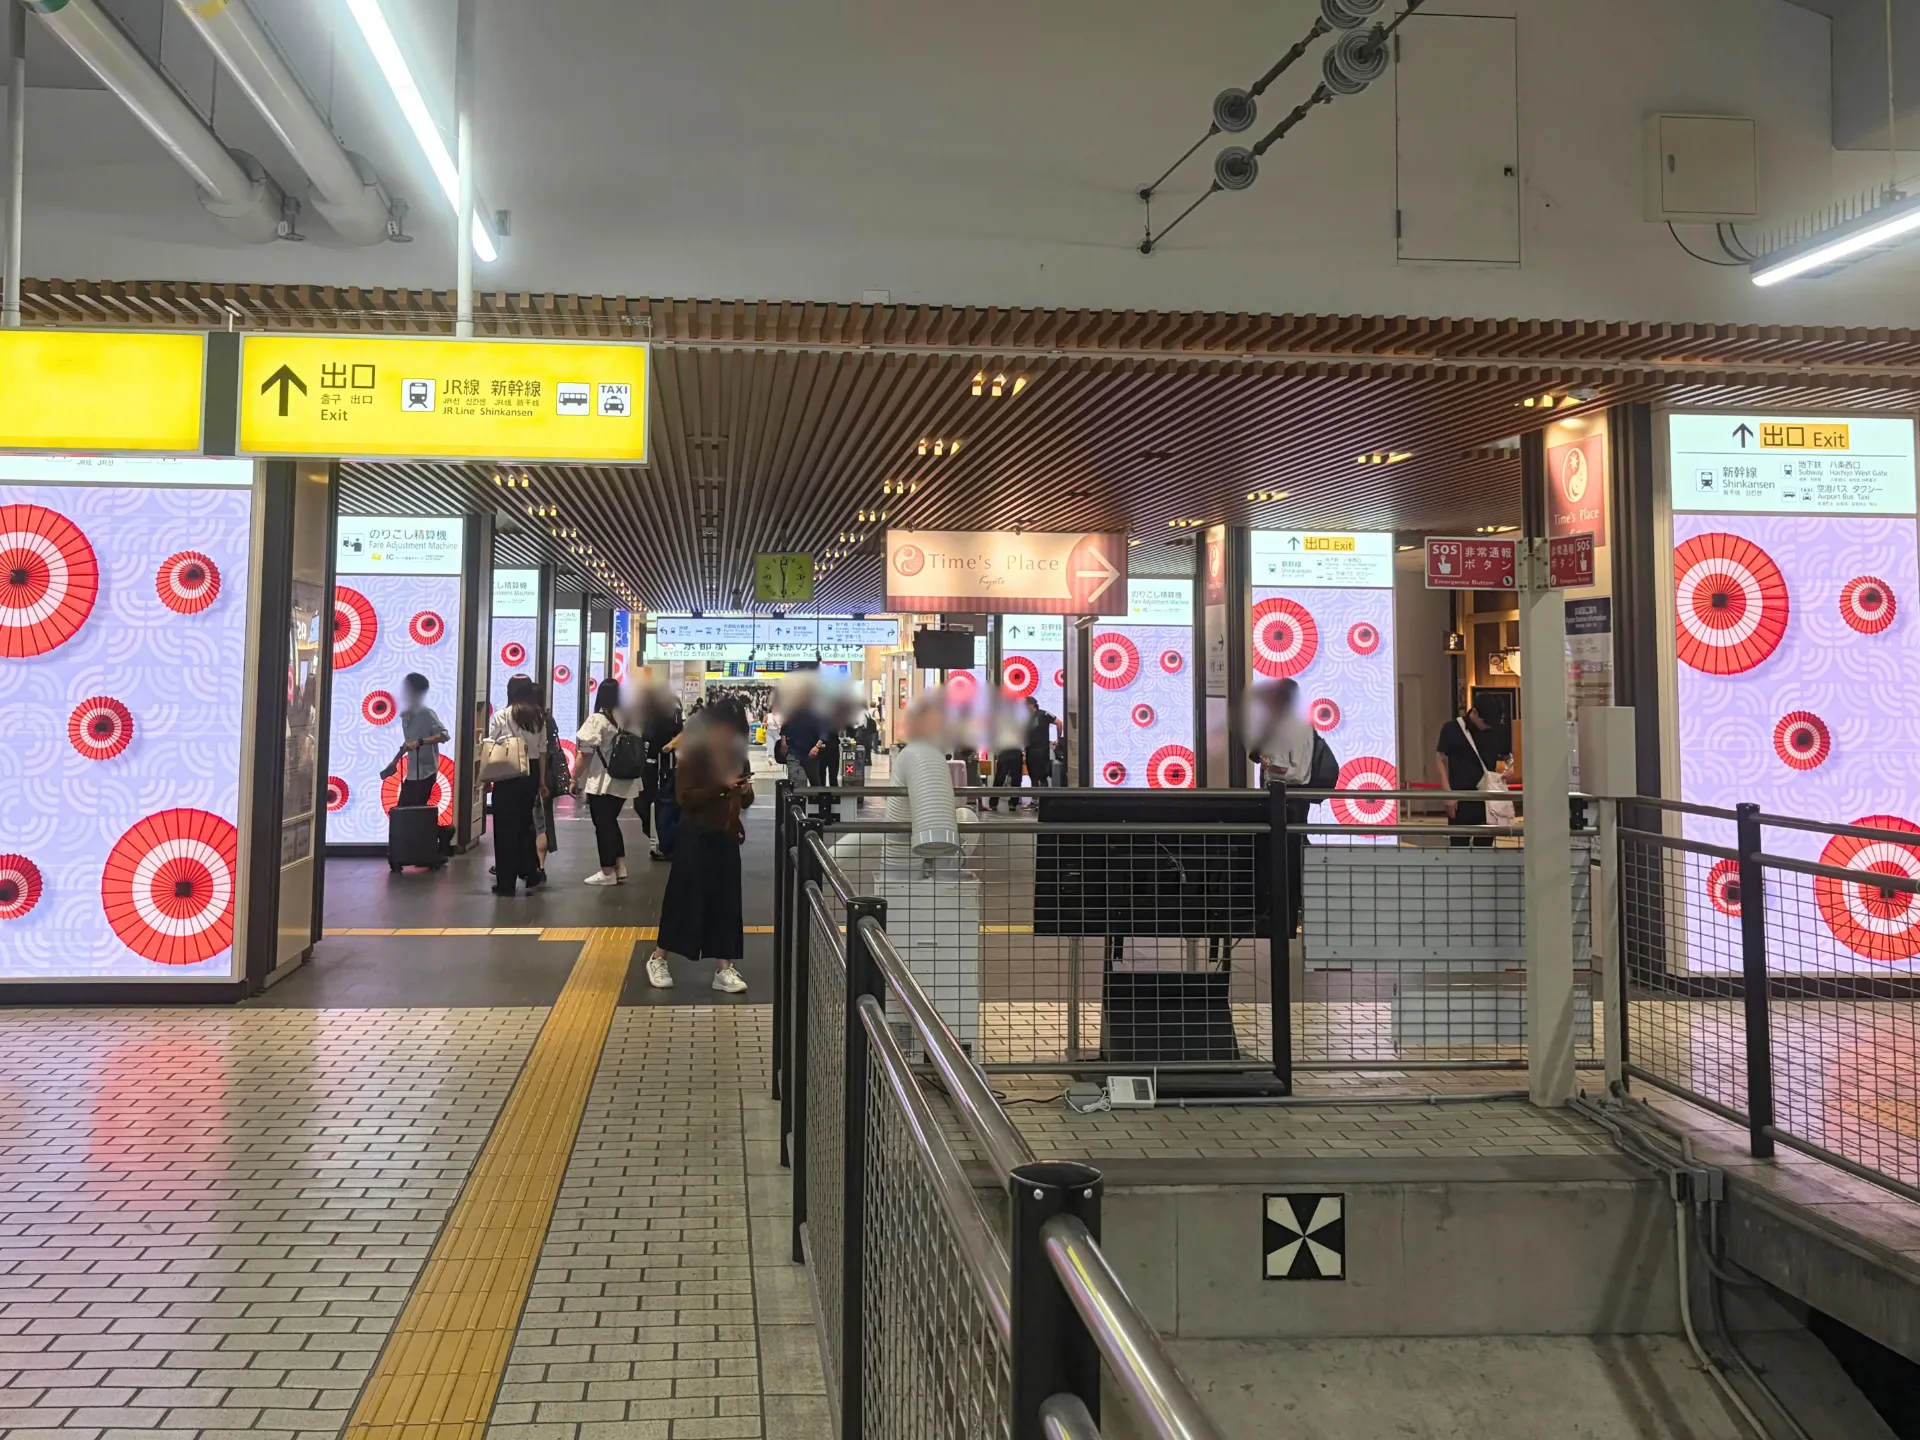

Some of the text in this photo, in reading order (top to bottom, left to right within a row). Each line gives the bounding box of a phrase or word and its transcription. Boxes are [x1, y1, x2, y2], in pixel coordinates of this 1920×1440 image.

[320, 362, 375, 389] 出口
[442, 379, 541, 397] JR線 新幹線
[600, 385, 628, 394] TAXI
[320, 394, 373, 405] 출구 出口
[320, 409, 348, 421] Exit
[442, 407, 533, 417] JR Line Shinkansen
[1763, 425, 1846, 448] 出口 Exit
[1798, 461, 1822, 469] 地下鉄
[1722, 466, 1757, 479] 新幹線
[1798, 469, 1823, 477] Subway
[1855, 469, 1871, 477] West
[1722, 479, 1775, 489] Shinkansen
[1816, 484, 1883, 493] 空港バス タクシー
[1817, 493, 1841, 503] Airport
[1553, 507, 1600, 526] Time's Place
[369, 530, 447, 541] のりこし精算機
[368, 540, 459, 552] Fare Adjustment Machine
[1305, 536, 1353, 551] 出口 Exit
[1576, 540, 1591, 552] SOS
[1432, 544, 1458, 555] SOS
[1464, 546, 1513, 558] 非常通報
[386, 553, 395, 561] IC
[928, 553, 1059, 571] Time's Place
[1464, 560, 1512, 570] ボタン
[978, 574, 1006, 590] Kyoto
[1434, 578, 1470, 586] Emergency
